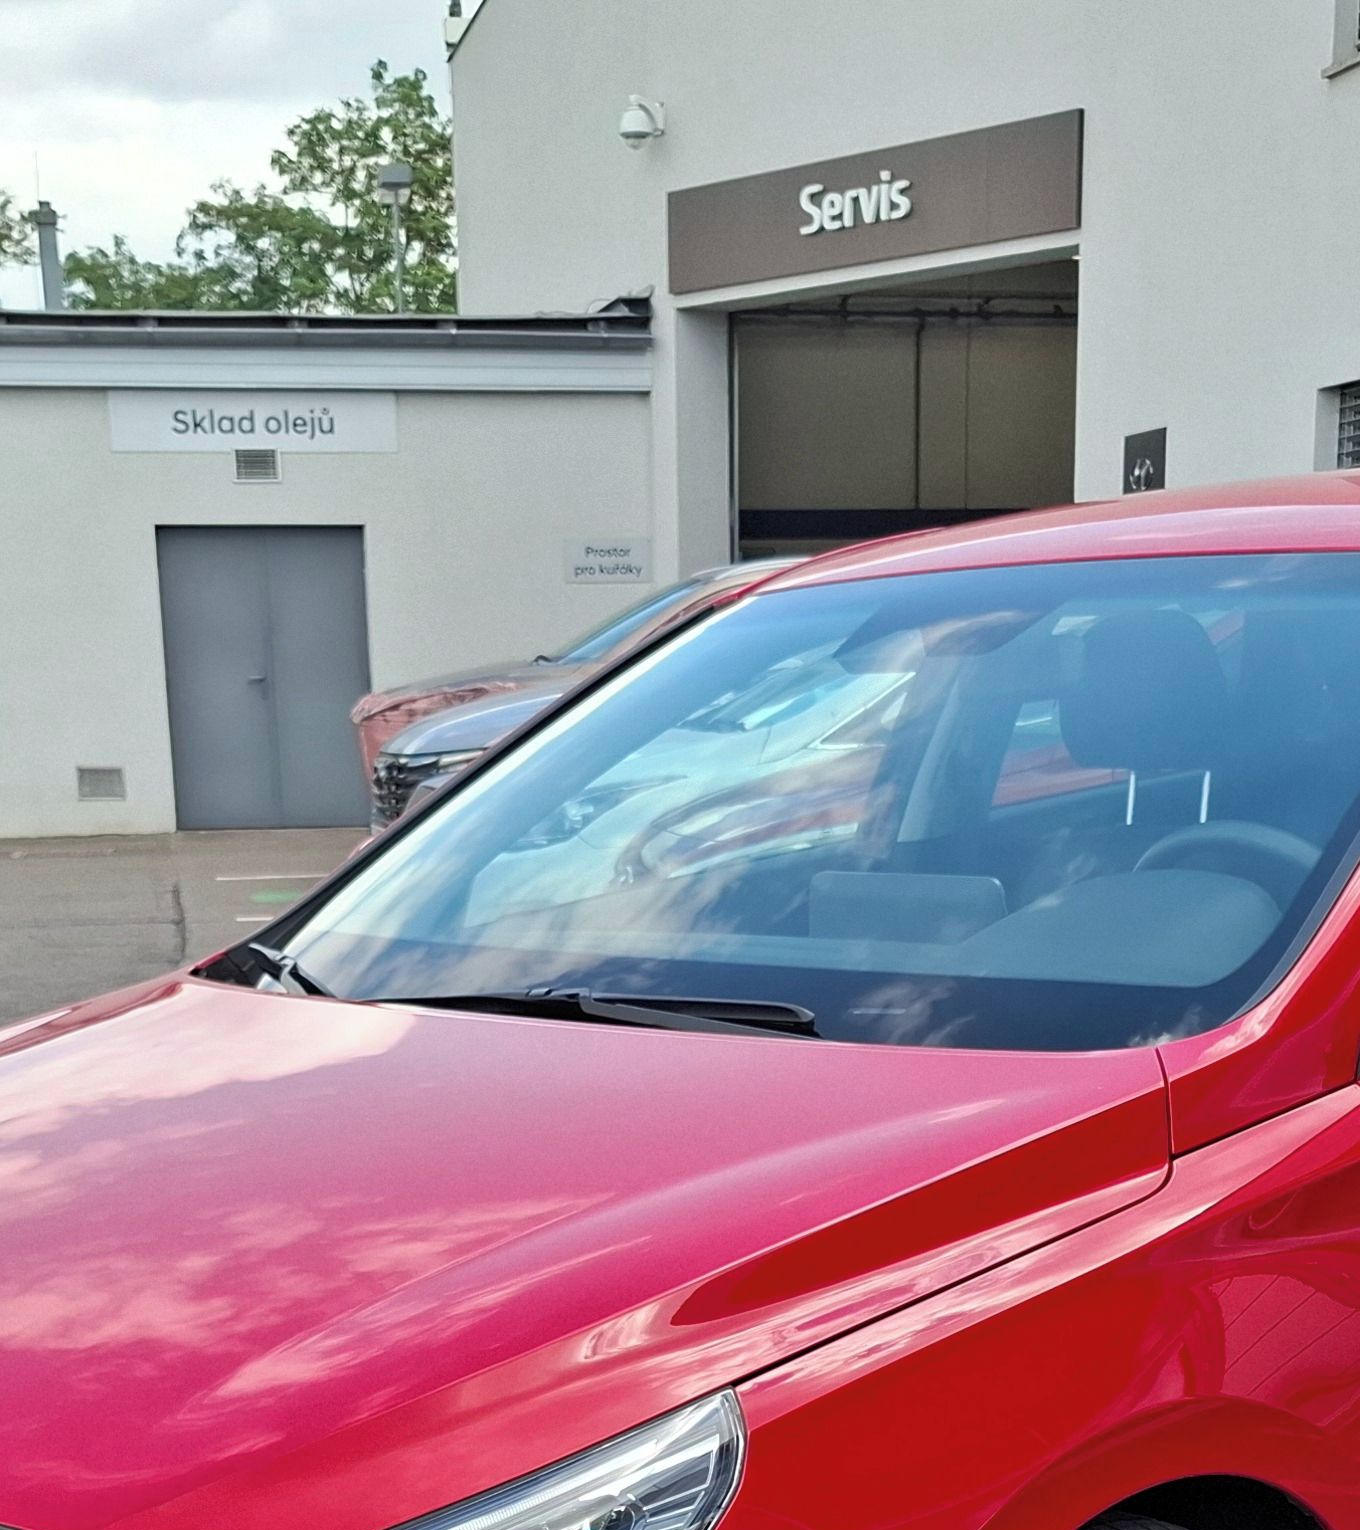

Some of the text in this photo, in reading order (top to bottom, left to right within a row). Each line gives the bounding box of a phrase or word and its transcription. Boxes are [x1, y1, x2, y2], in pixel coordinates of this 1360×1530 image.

[799, 170, 912, 236] Servis
[172, 407, 335, 440] Sklad olejů
[585, 546, 631, 558] Prostor
[574, 566, 596, 578] pro
